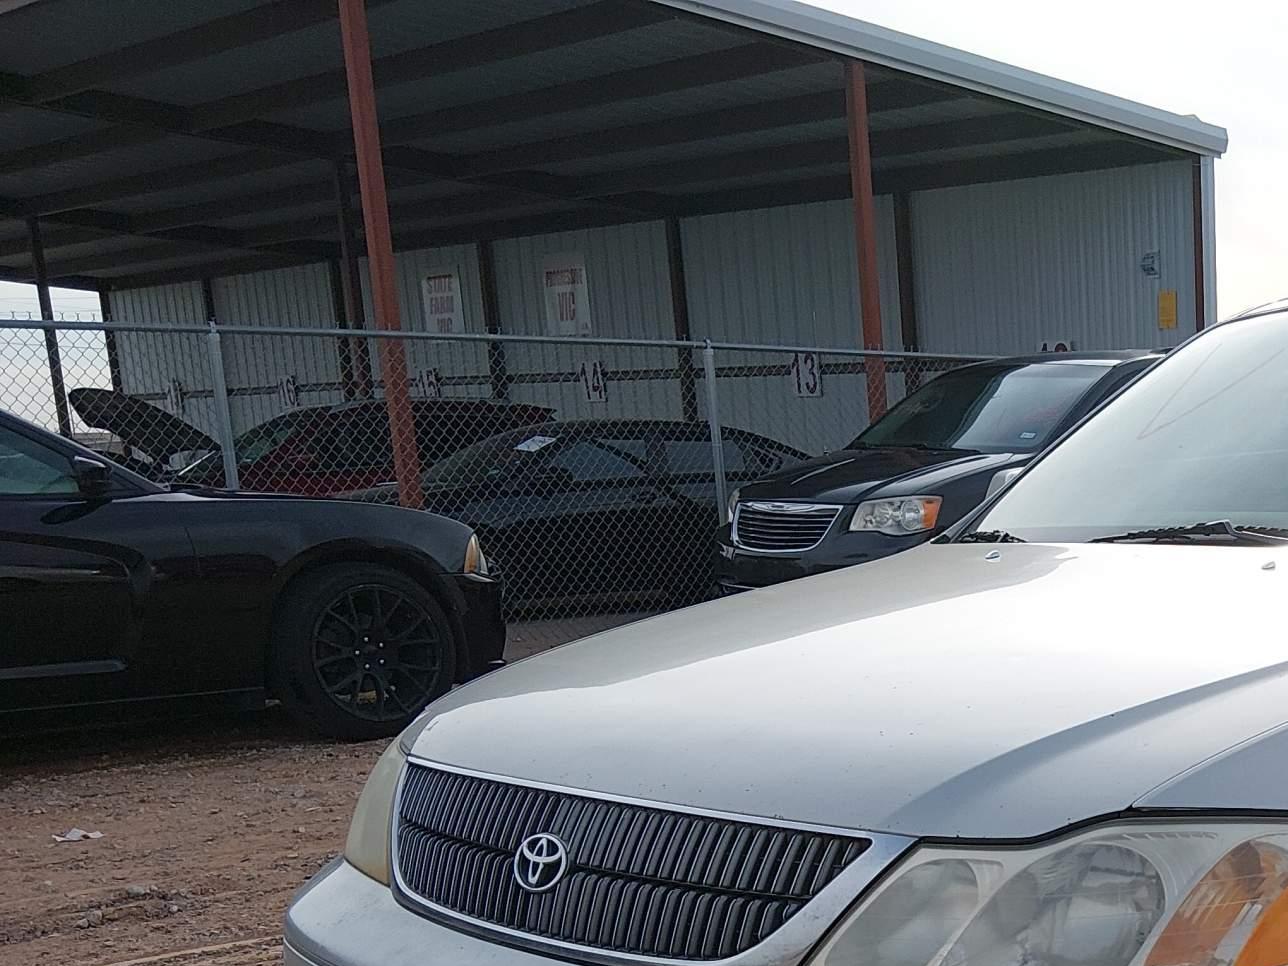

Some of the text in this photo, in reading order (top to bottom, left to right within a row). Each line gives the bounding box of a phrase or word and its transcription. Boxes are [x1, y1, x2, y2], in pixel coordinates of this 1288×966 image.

[427, 273, 453, 295] STATE
[557, 291, 577, 321] VIC
[580, 362, 603, 401] 14
[791, 352, 818, 395] 13
